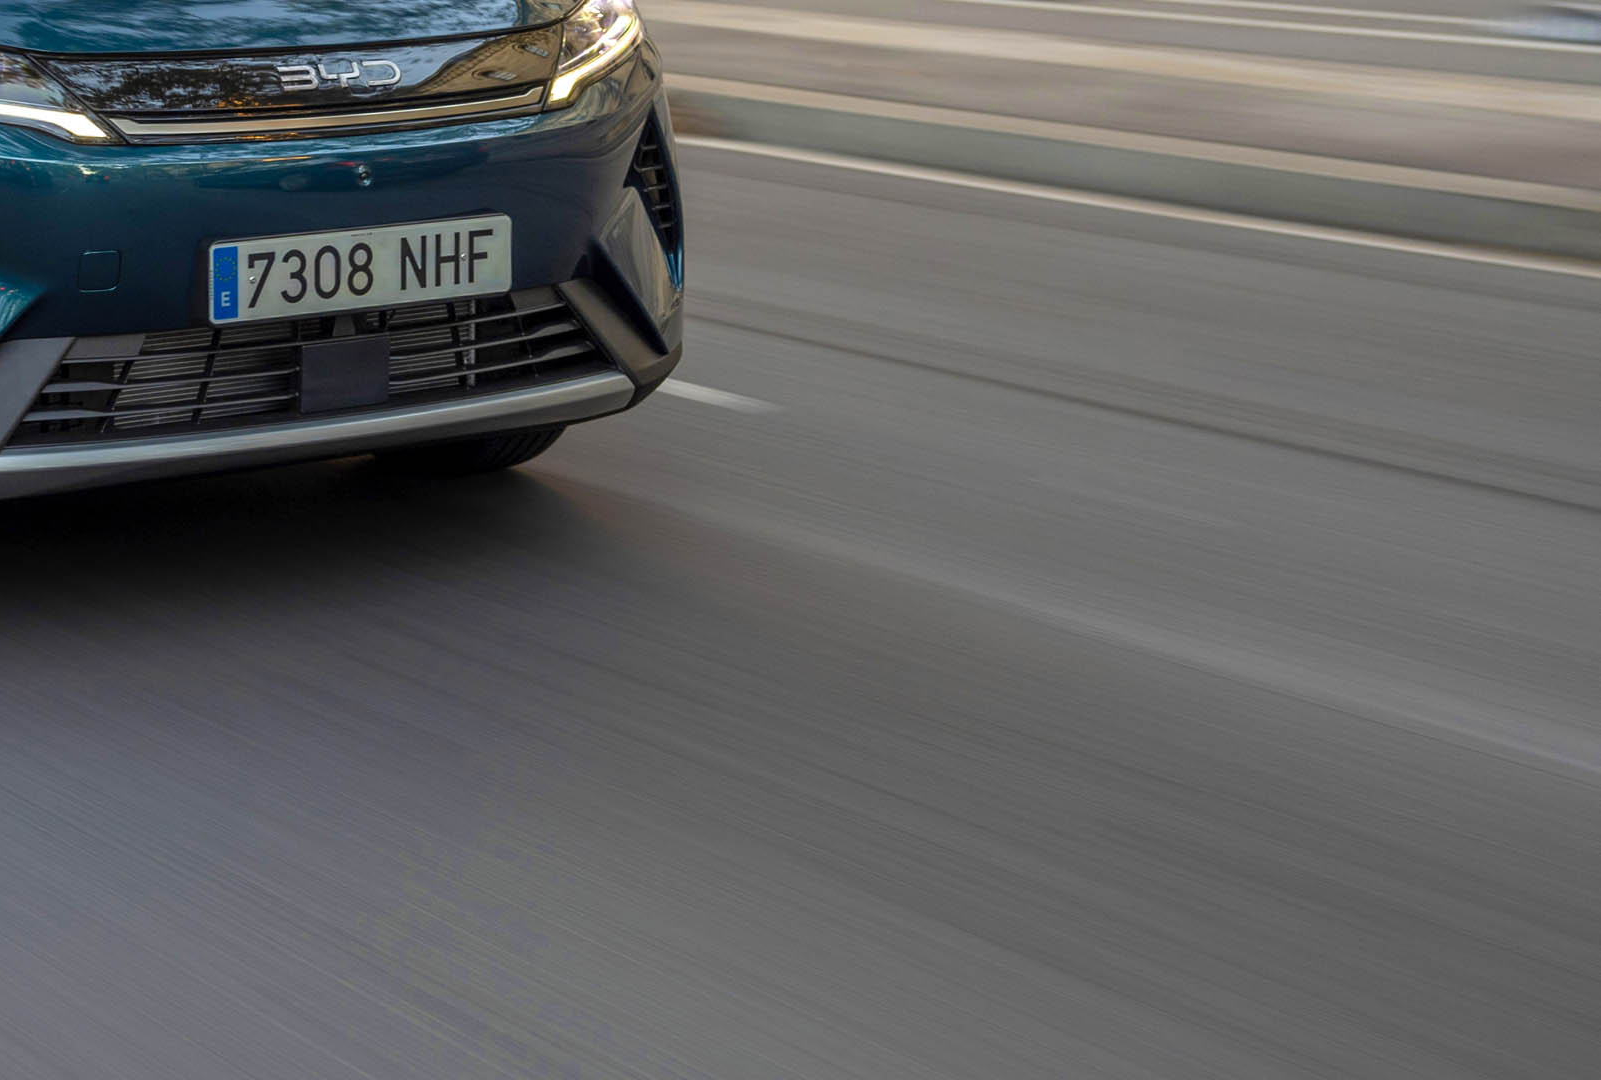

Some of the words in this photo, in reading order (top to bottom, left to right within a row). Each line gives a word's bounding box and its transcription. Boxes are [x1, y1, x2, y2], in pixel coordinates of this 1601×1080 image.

[276, 60, 401, 92] BYD
[221, 291, 231, 307] E
[247, 242, 374, 309] 7308
[400, 228, 494, 291] NHF
